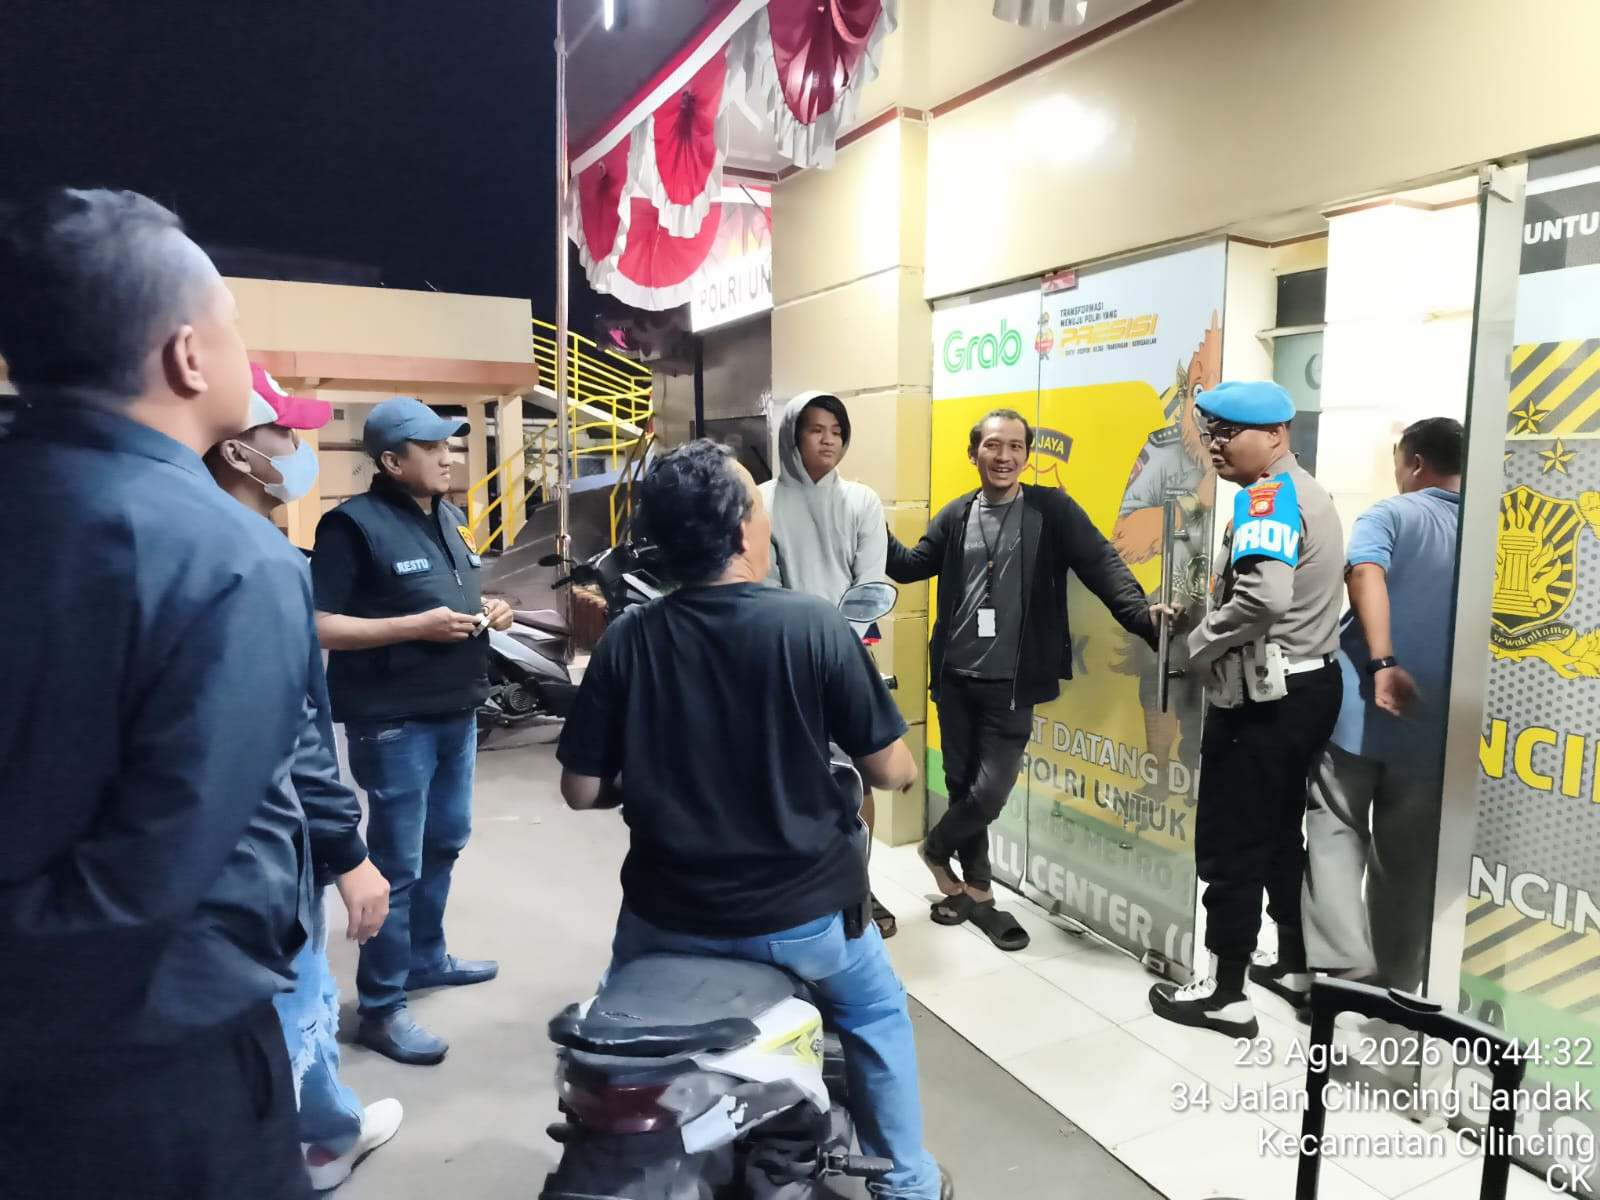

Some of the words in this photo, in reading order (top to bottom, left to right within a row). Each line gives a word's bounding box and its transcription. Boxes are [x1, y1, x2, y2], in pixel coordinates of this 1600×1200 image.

[1524, 211, 1600, 244] UNTU
[700, 273, 742, 312] POLRI
[1060, 301, 1104, 317] TRANSFORMASI
[1060, 313, 1159, 348] PRESISI
[1103, 309, 1118, 320] YANG
[943, 318, 1022, 373] Grab
[1038, 435, 1065, 455] JAYA
[396, 558, 429, 572] RESTU
[1053, 720, 1159, 785] DATANG
[1021, 751, 1085, 800] POLRI
[1094, 778, 1187, 841] UNTUK
[1031, 854, 1153, 949] CENTER
